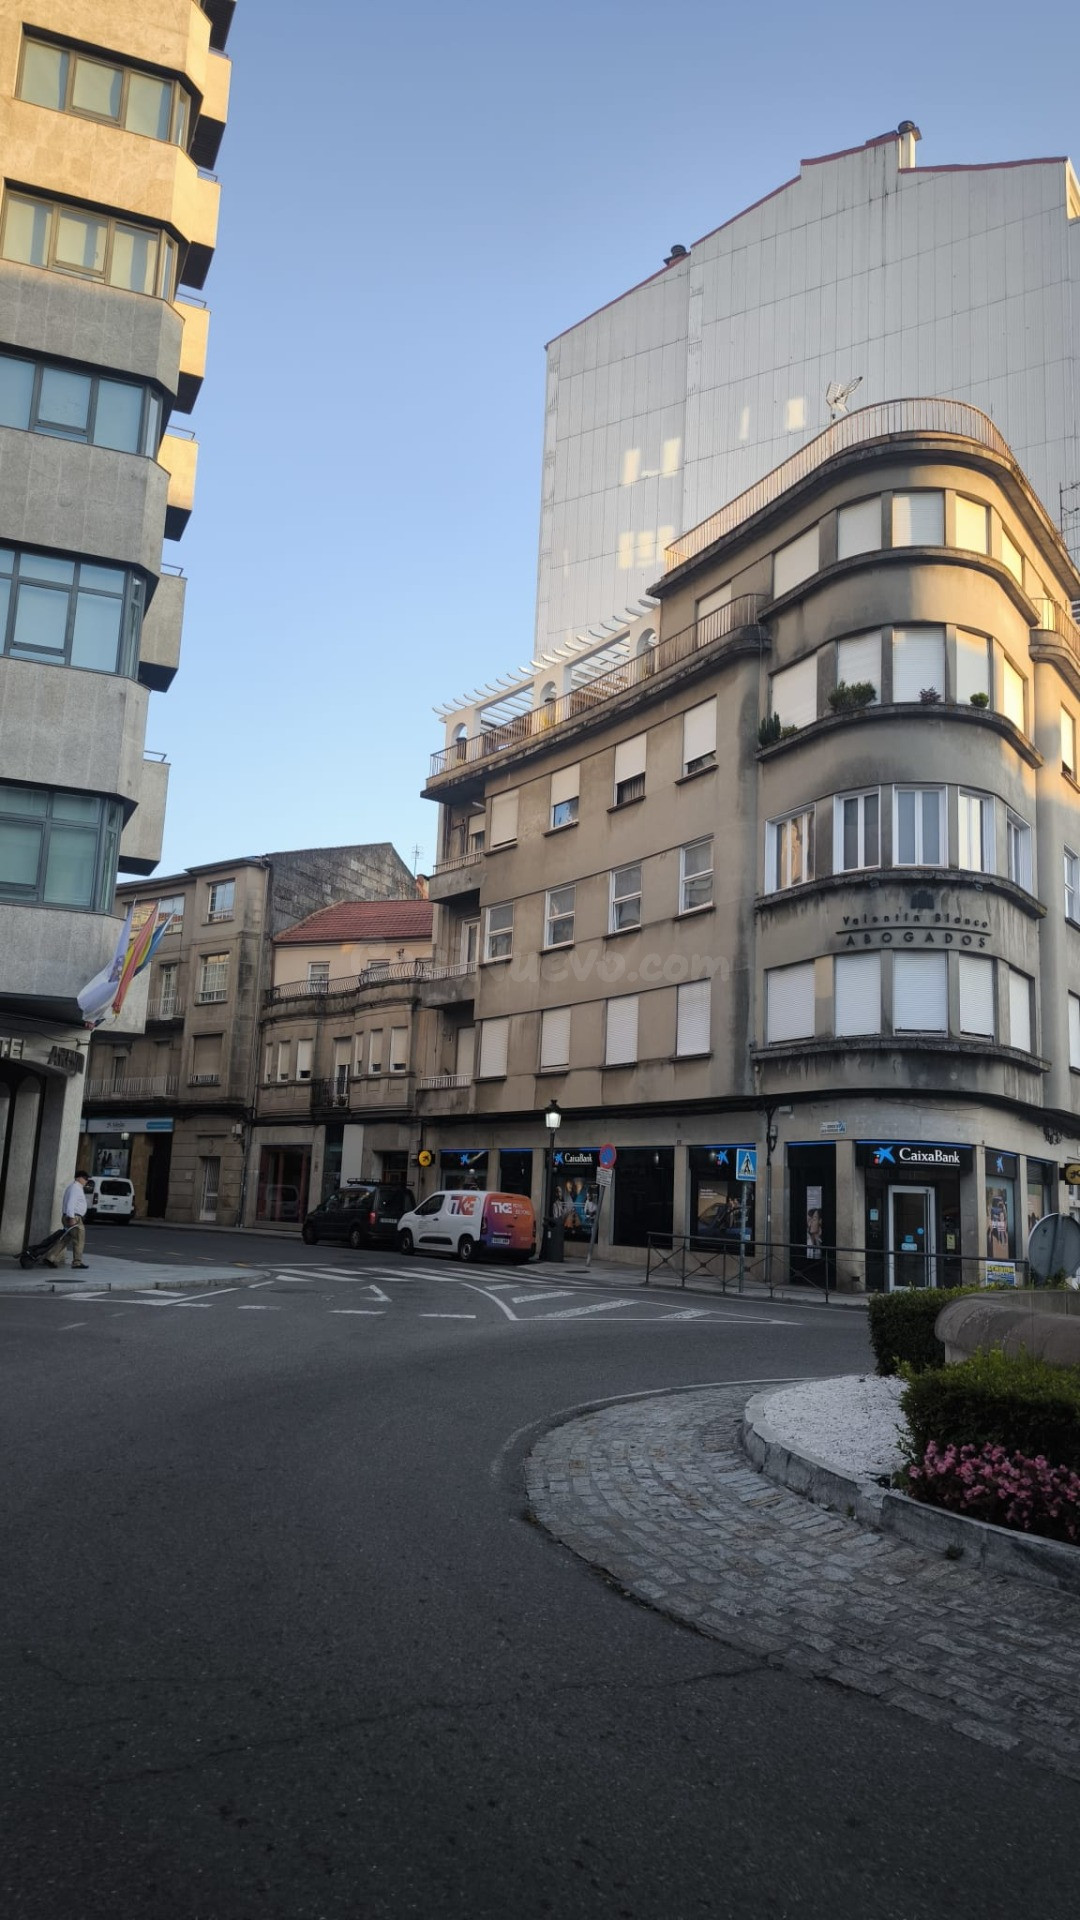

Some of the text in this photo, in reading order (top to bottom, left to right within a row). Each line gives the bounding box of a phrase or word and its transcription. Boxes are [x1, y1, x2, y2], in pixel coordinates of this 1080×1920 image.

[933, 912, 988, 929] Blanco
[846, 931, 986, 948] ABOGADOS
[898, 1147, 961, 1164] CaixaBank
